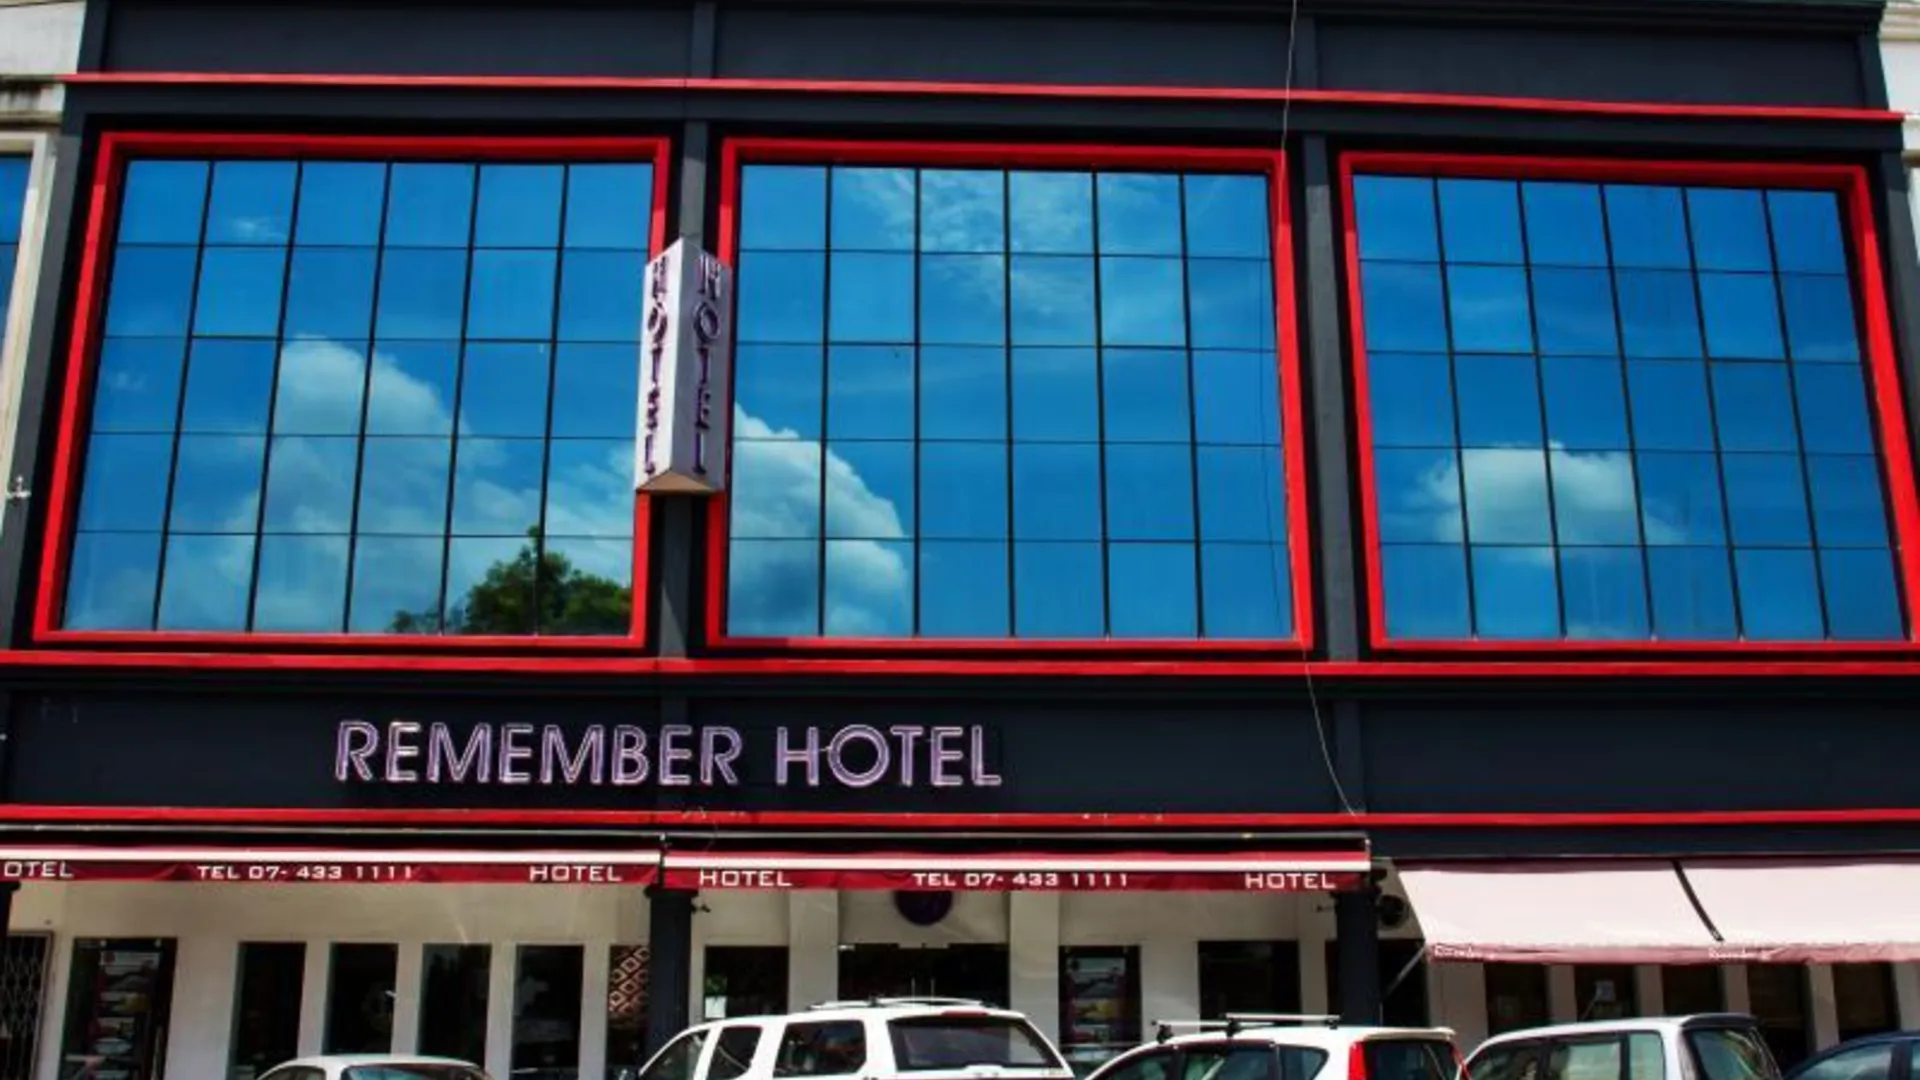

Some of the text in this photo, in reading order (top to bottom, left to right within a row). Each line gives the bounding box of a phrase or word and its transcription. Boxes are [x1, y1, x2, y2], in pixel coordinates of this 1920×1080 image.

[644, 255, 668, 475] HOTEL
[693, 254, 722, 475] HOTEL
[334, 720, 1002, 787] REMEMBER HOTEL
[197, 865, 413, 880] TEL 07- 433 1111
[528, 865, 623, 882] HOTEL
[699, 870, 793, 887] HOTEL
[911, 872, 1128, 887] TEL 07- 433 1111
[1244, 872, 1337, 889] HOTEL
